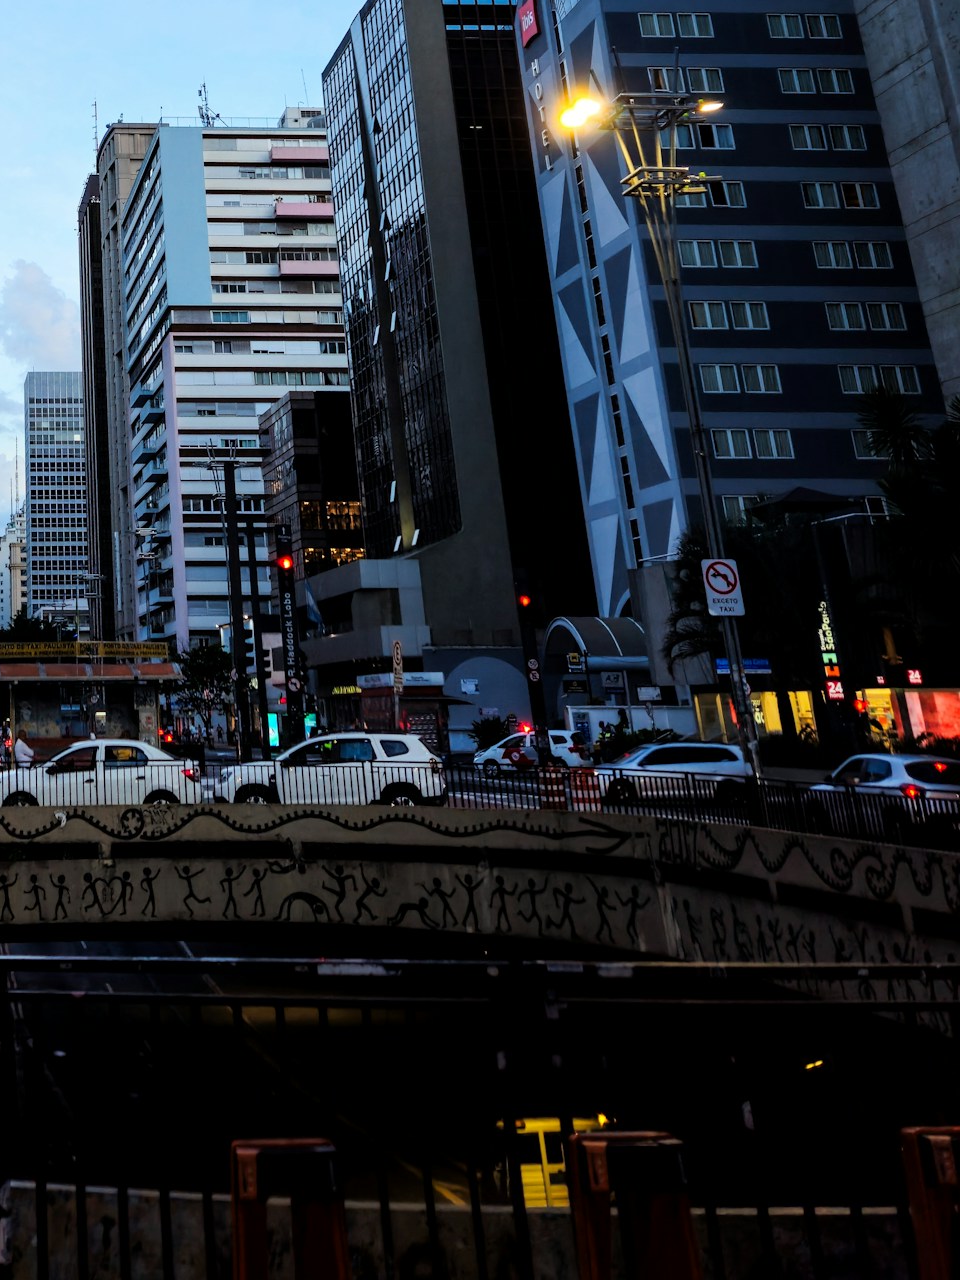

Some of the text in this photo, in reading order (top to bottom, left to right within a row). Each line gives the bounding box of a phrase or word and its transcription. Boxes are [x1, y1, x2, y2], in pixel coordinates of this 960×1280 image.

[522, 11, 534, 32] ibis
[530, 58, 553, 172] HOTEL
[283, 592, 293, 618] Lobo
[27, 642, 41, 650] TAXI
[285, 620, 296, 665] Haddock
[908, 669, 921, 679] 24
[827, 681, 843, 692] 24
